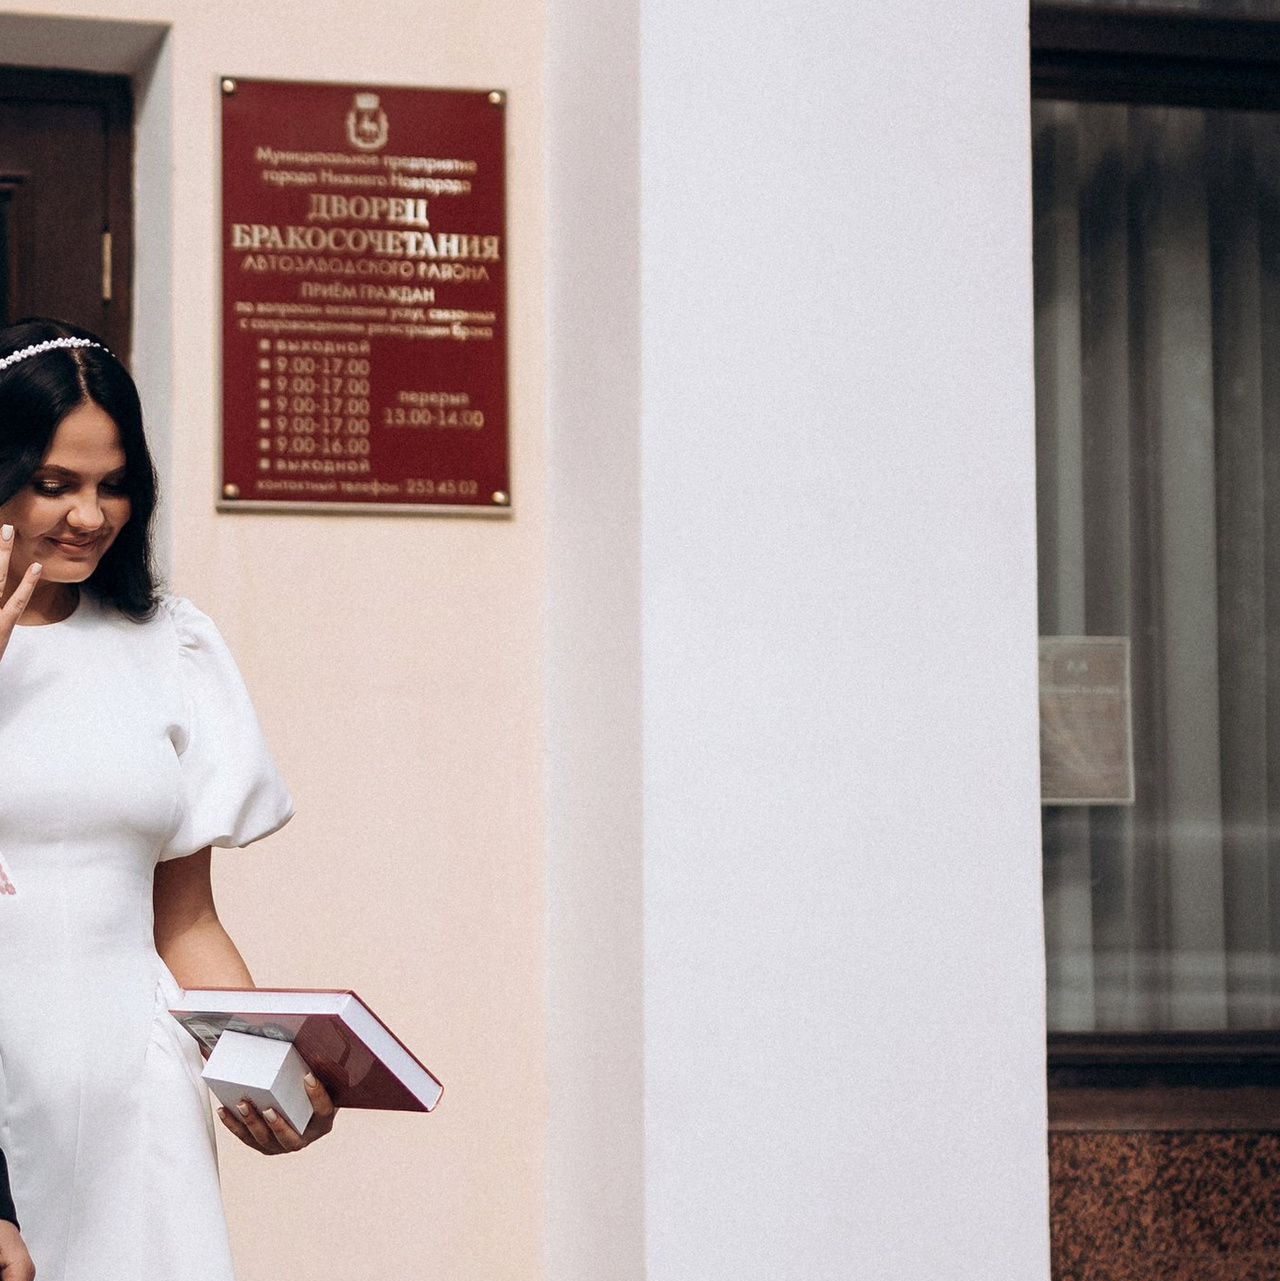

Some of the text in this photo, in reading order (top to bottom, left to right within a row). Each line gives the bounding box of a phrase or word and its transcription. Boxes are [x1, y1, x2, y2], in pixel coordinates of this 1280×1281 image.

[256, 146, 477, 175] Муниципальное предприятие
[391, 174, 472, 196] Новгорода
[308, 193, 430, 228] ДВОРЕЦ
[231, 223, 501, 260] БРАКОСОЧЕТАНИЯ
[241, 254, 491, 283] АВТОЗАВОДСКОГО РАЙОНА
[360, 284, 436, 304] ГРАЖДАН
[451, 321, 493, 341] брака
[399, 390, 469, 407] перерыв
